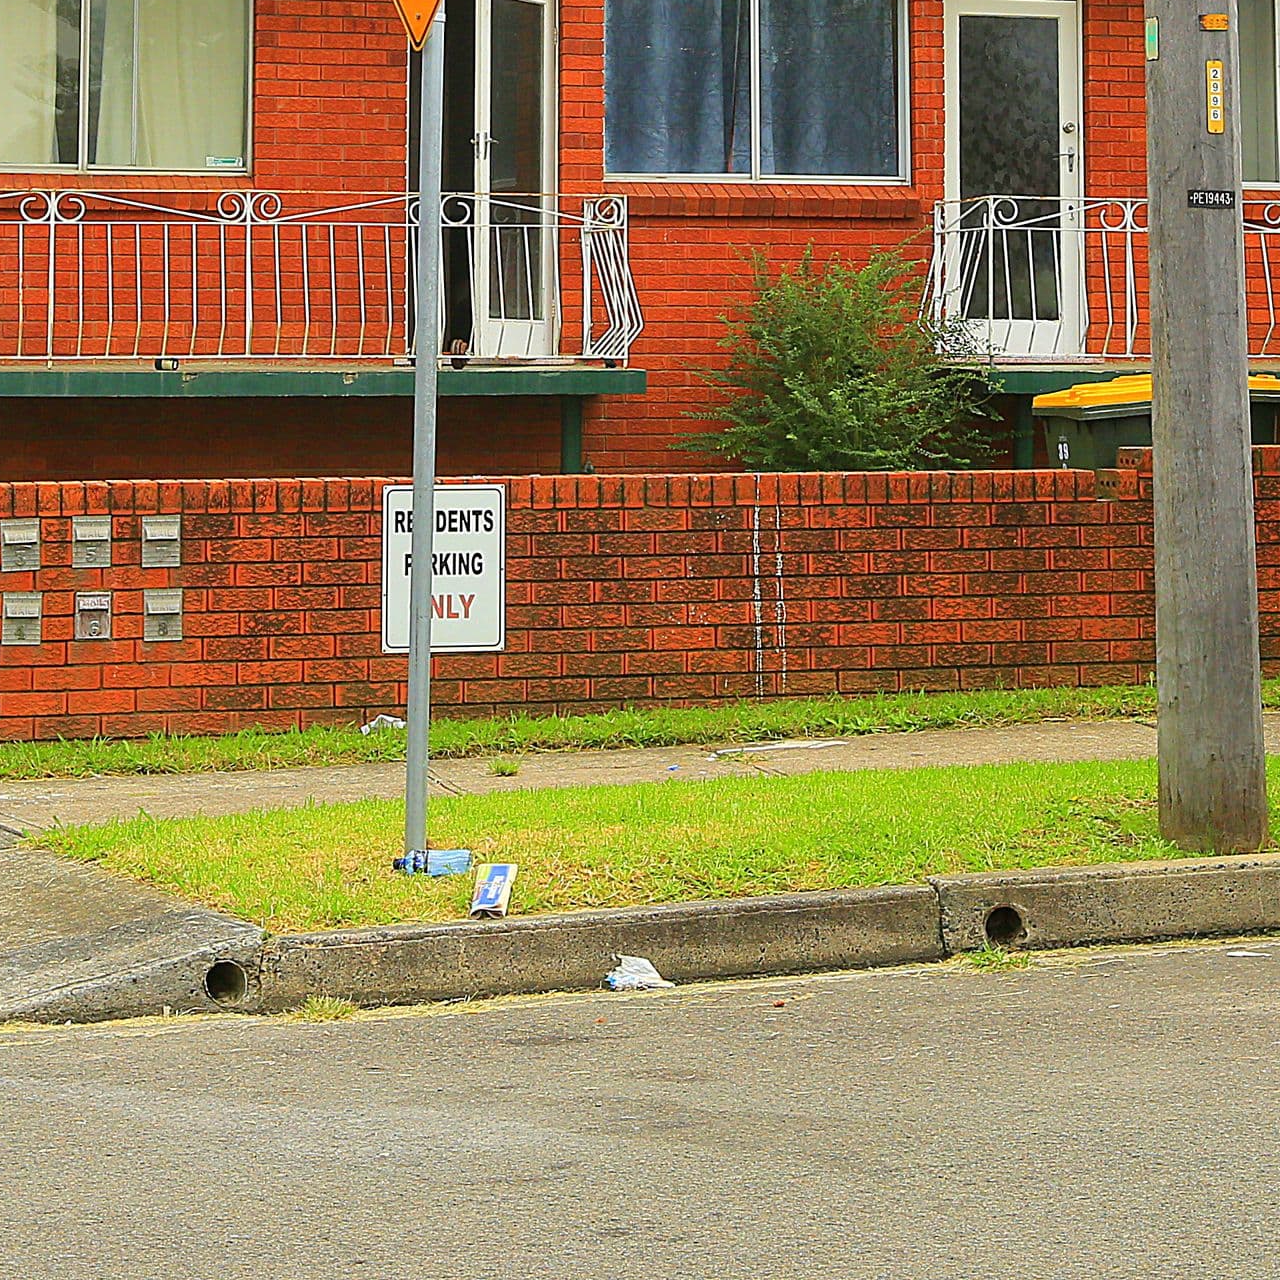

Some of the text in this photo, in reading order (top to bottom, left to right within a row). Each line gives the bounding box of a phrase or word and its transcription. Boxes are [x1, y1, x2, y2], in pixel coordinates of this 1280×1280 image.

[1193, 192, 1231, 205] PE19443
[395, 510, 494, 533] REDENTS
[405, 553, 483, 576] PRKING
[431, 594, 475, 619] NLY
